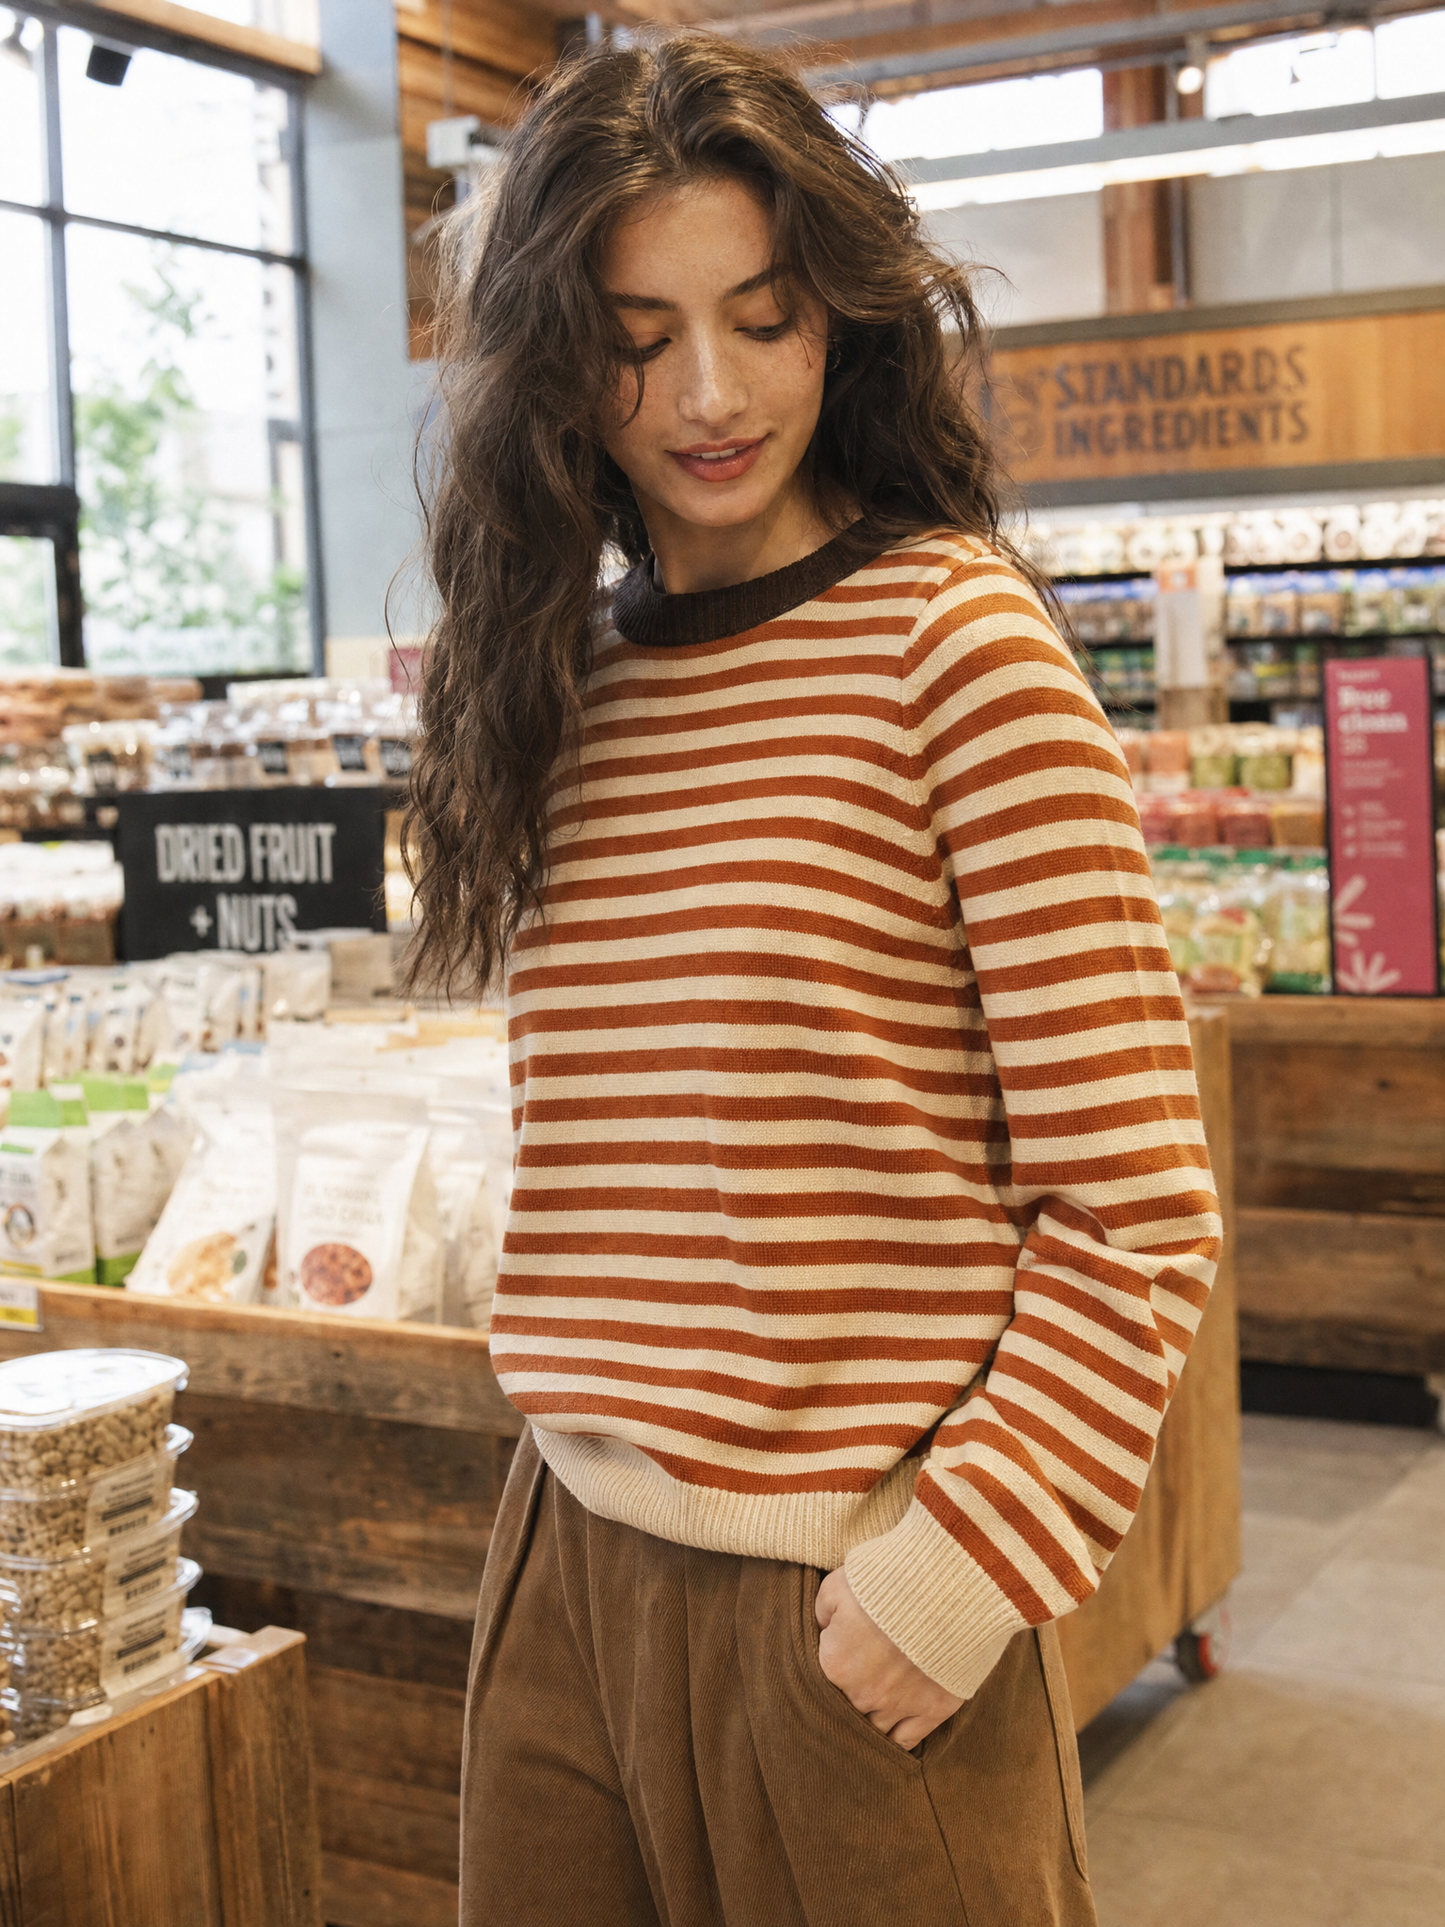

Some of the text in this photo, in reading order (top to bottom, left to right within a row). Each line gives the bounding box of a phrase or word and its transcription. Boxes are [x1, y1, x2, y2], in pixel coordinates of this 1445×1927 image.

[1053, 344, 1309, 409] STANDARDS
[1052, 402, 1310, 460] INGREDIENTS
[154, 822, 337, 884] DRIED FRUIT
[216, 892, 299, 952] NUTS
